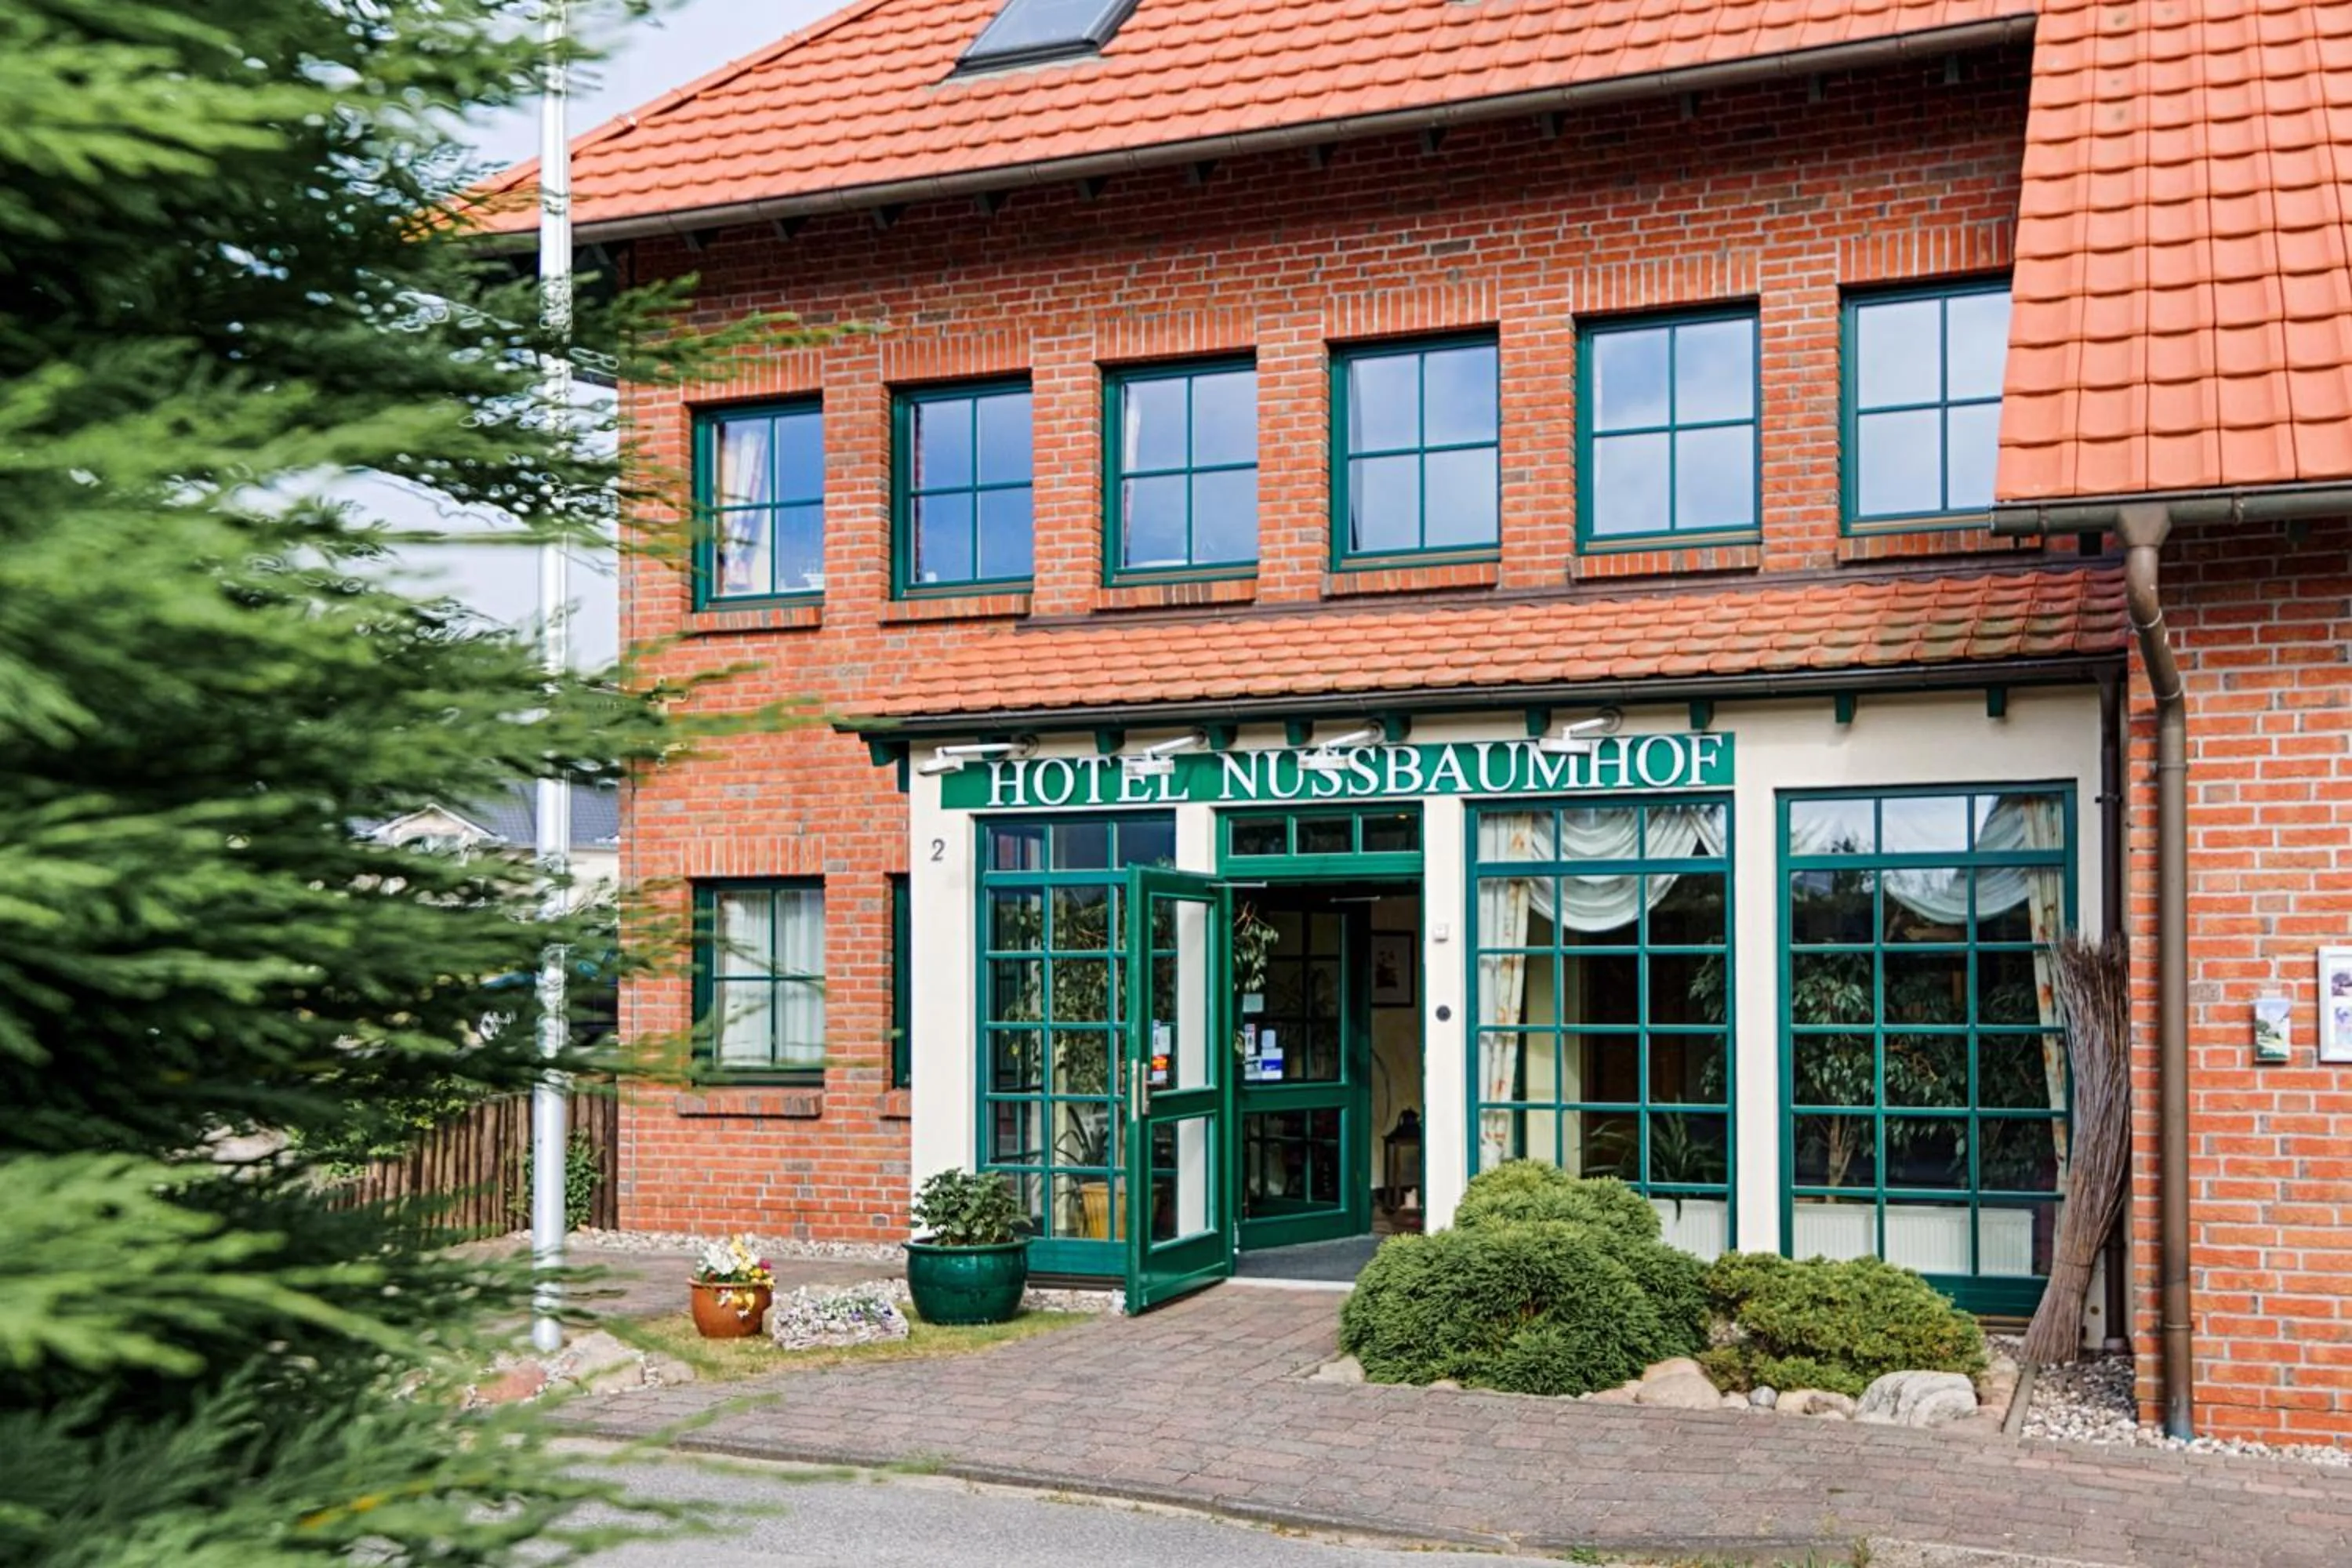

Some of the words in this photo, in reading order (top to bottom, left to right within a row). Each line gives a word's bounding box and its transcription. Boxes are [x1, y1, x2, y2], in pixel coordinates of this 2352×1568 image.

[985, 754, 1189, 806] HOTEL
[1216, 735, 1723, 800] NUSSBAUMHOF
[931, 838, 946, 862] 2
